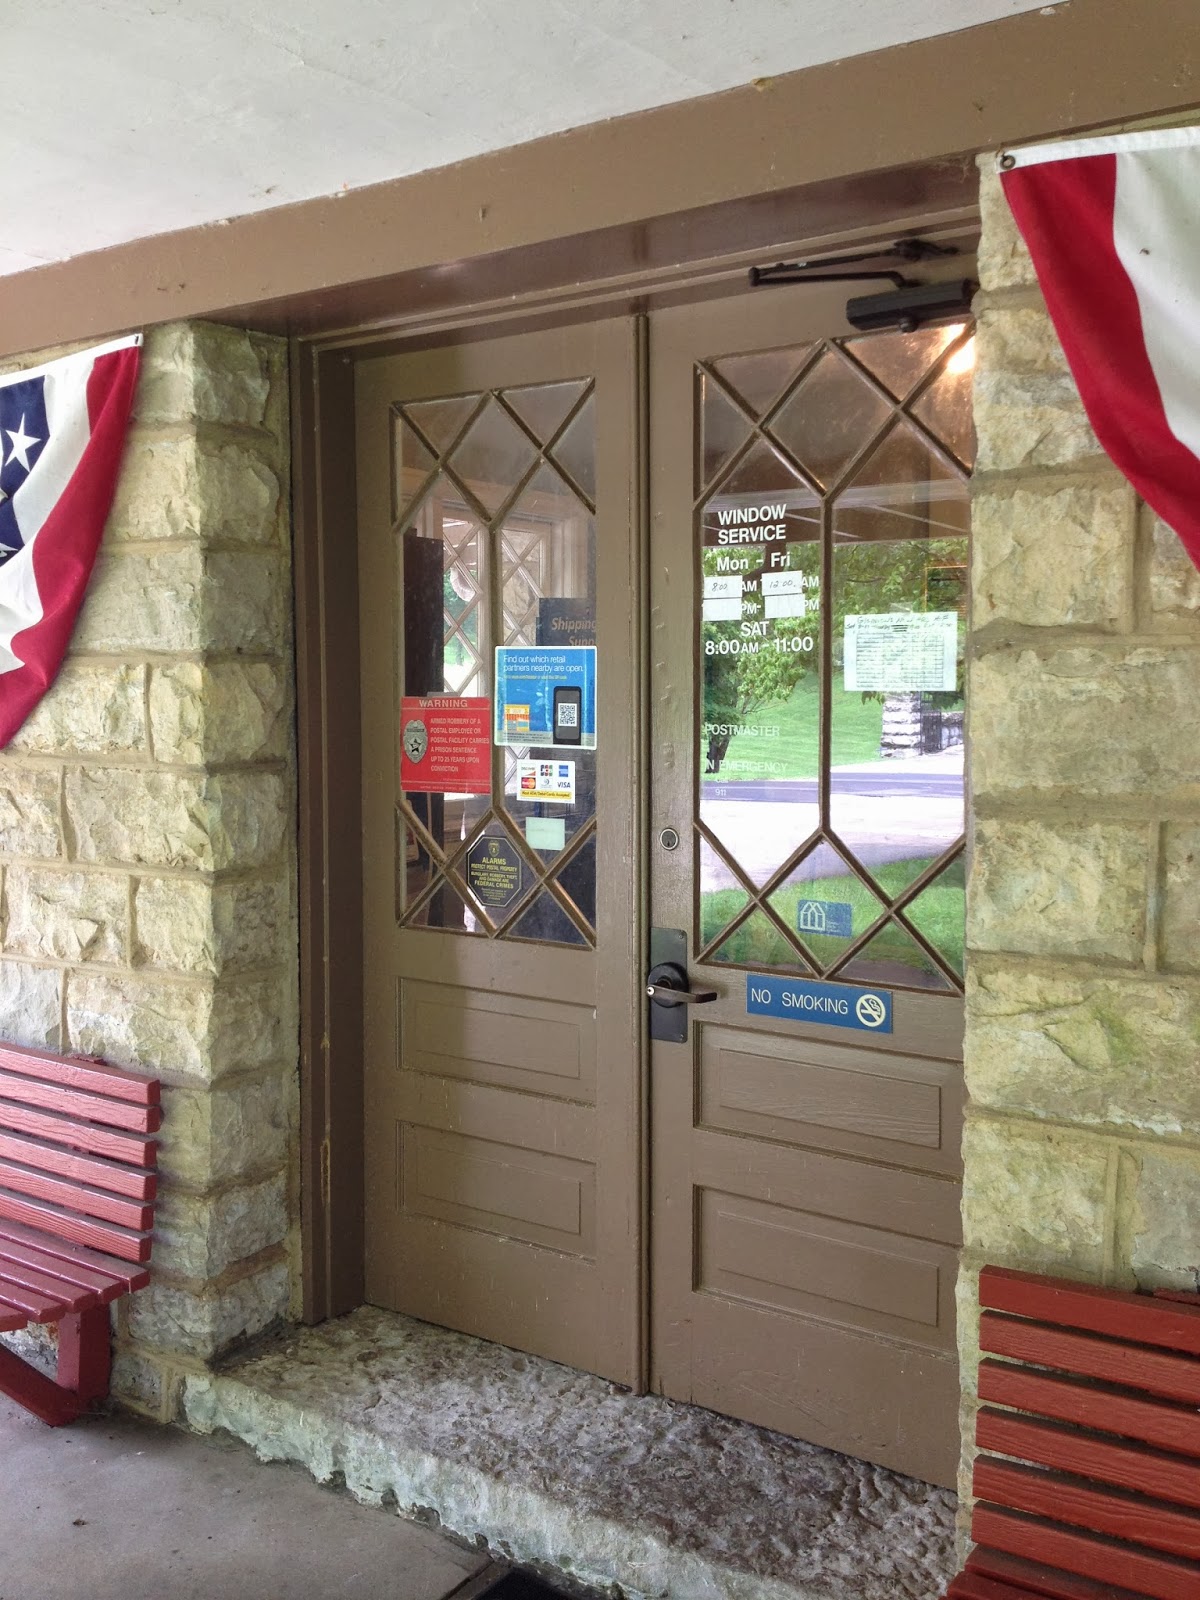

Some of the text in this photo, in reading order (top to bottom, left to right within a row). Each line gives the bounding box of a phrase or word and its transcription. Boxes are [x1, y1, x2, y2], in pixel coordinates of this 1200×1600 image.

[718, 504, 787, 525] WINDOW
[718, 524, 786, 544] SERVICE
[717, 557, 748, 571] Mon
[771, 552, 790, 567] Fri
[741, 580, 757, 592] AM
[802, 576, 819, 588] AM
[804, 599, 819, 610] PM
[551, 617, 596, 633] Shipping
[740, 621, 769, 636] SAT
[774, 636, 813, 652] 11:00
[503, 655, 517, 663] Find
[529, 655, 549, 663] which
[550, 655, 566, 663] retail
[503, 665, 529, 673] partners
[531, 664, 552, 673] nearby
[419, 699, 468, 708] WARNING
[705, 724, 780, 736] POSTMASTER
[719, 760, 788, 773] EMERGENCY
[715, 788, 727, 796] 911
[481, 857, 507, 865] ALARMS
[751, 988, 849, 1015] NO SMOKING
